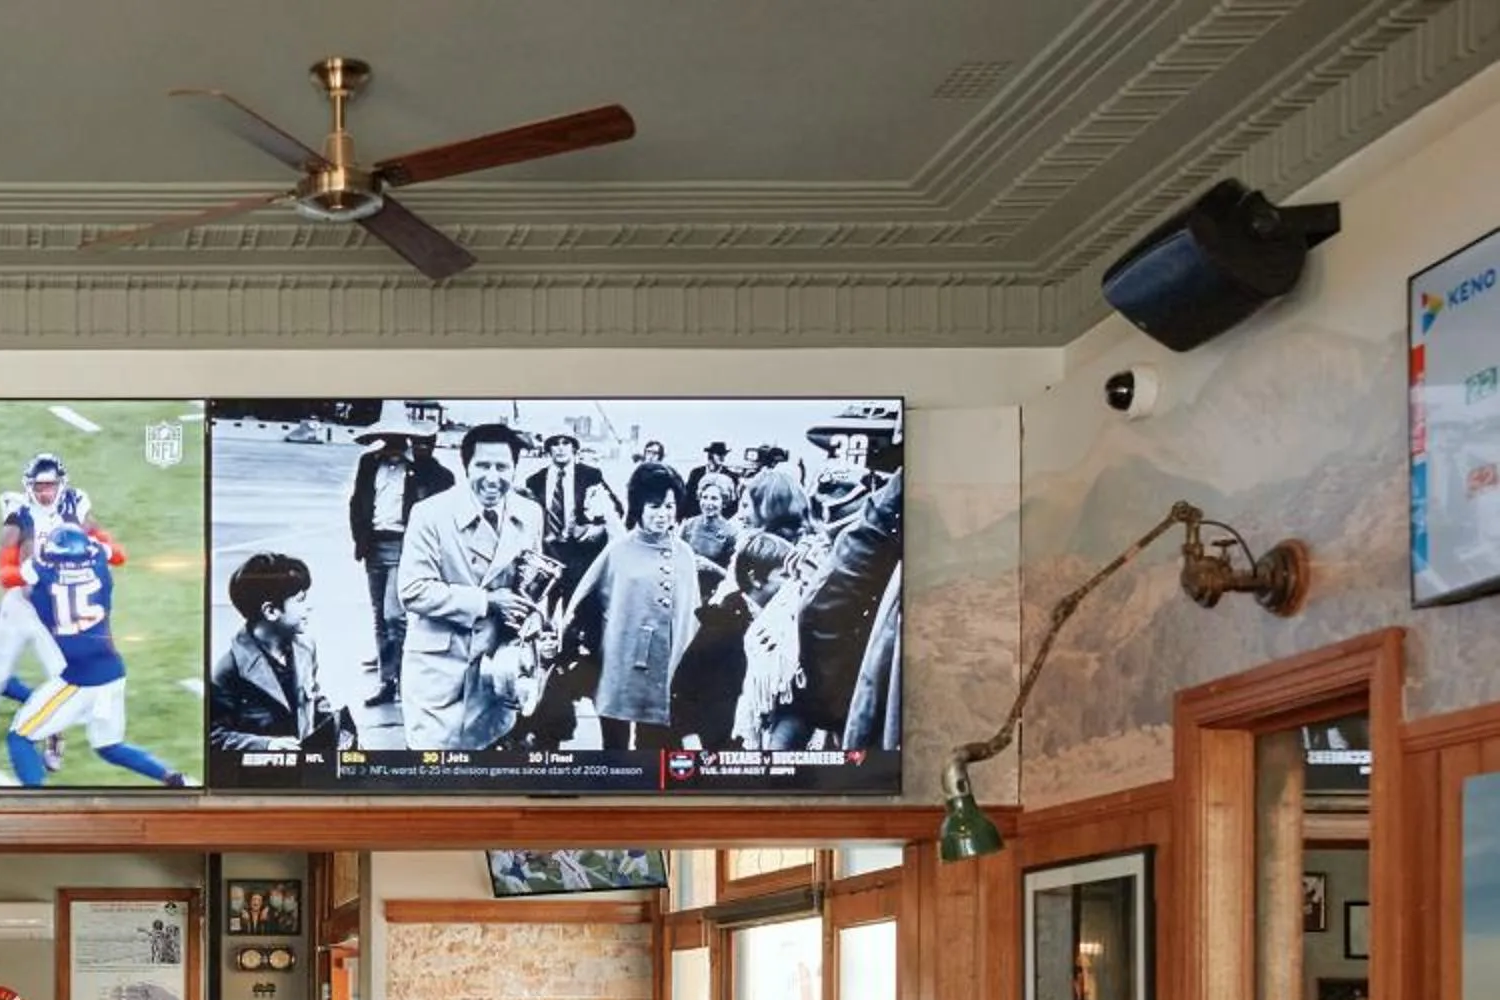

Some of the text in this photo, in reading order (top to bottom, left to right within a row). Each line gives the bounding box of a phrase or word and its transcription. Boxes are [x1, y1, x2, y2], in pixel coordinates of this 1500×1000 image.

[1446, 268, 1497, 310] KENO
[51, 577, 105, 635] 15
[305, 753, 324, 763] NFL
[341, 752, 439, 763] Bills 30
[446, 753, 543, 763] Jets 10
[719, 752, 761, 765] TEXANS
[772, 752, 845, 765] BUCCANEERS
[370, 766, 416, 775] NFL-worst
[453, 765, 488, 775] division
[490, 767, 520, 778] games
[521, 765, 547, 775] since
[548, 765, 571, 775] start
[572, 765, 582, 775] of
[583, 765, 607, 775] 2020
[609, 767, 642, 775] season
